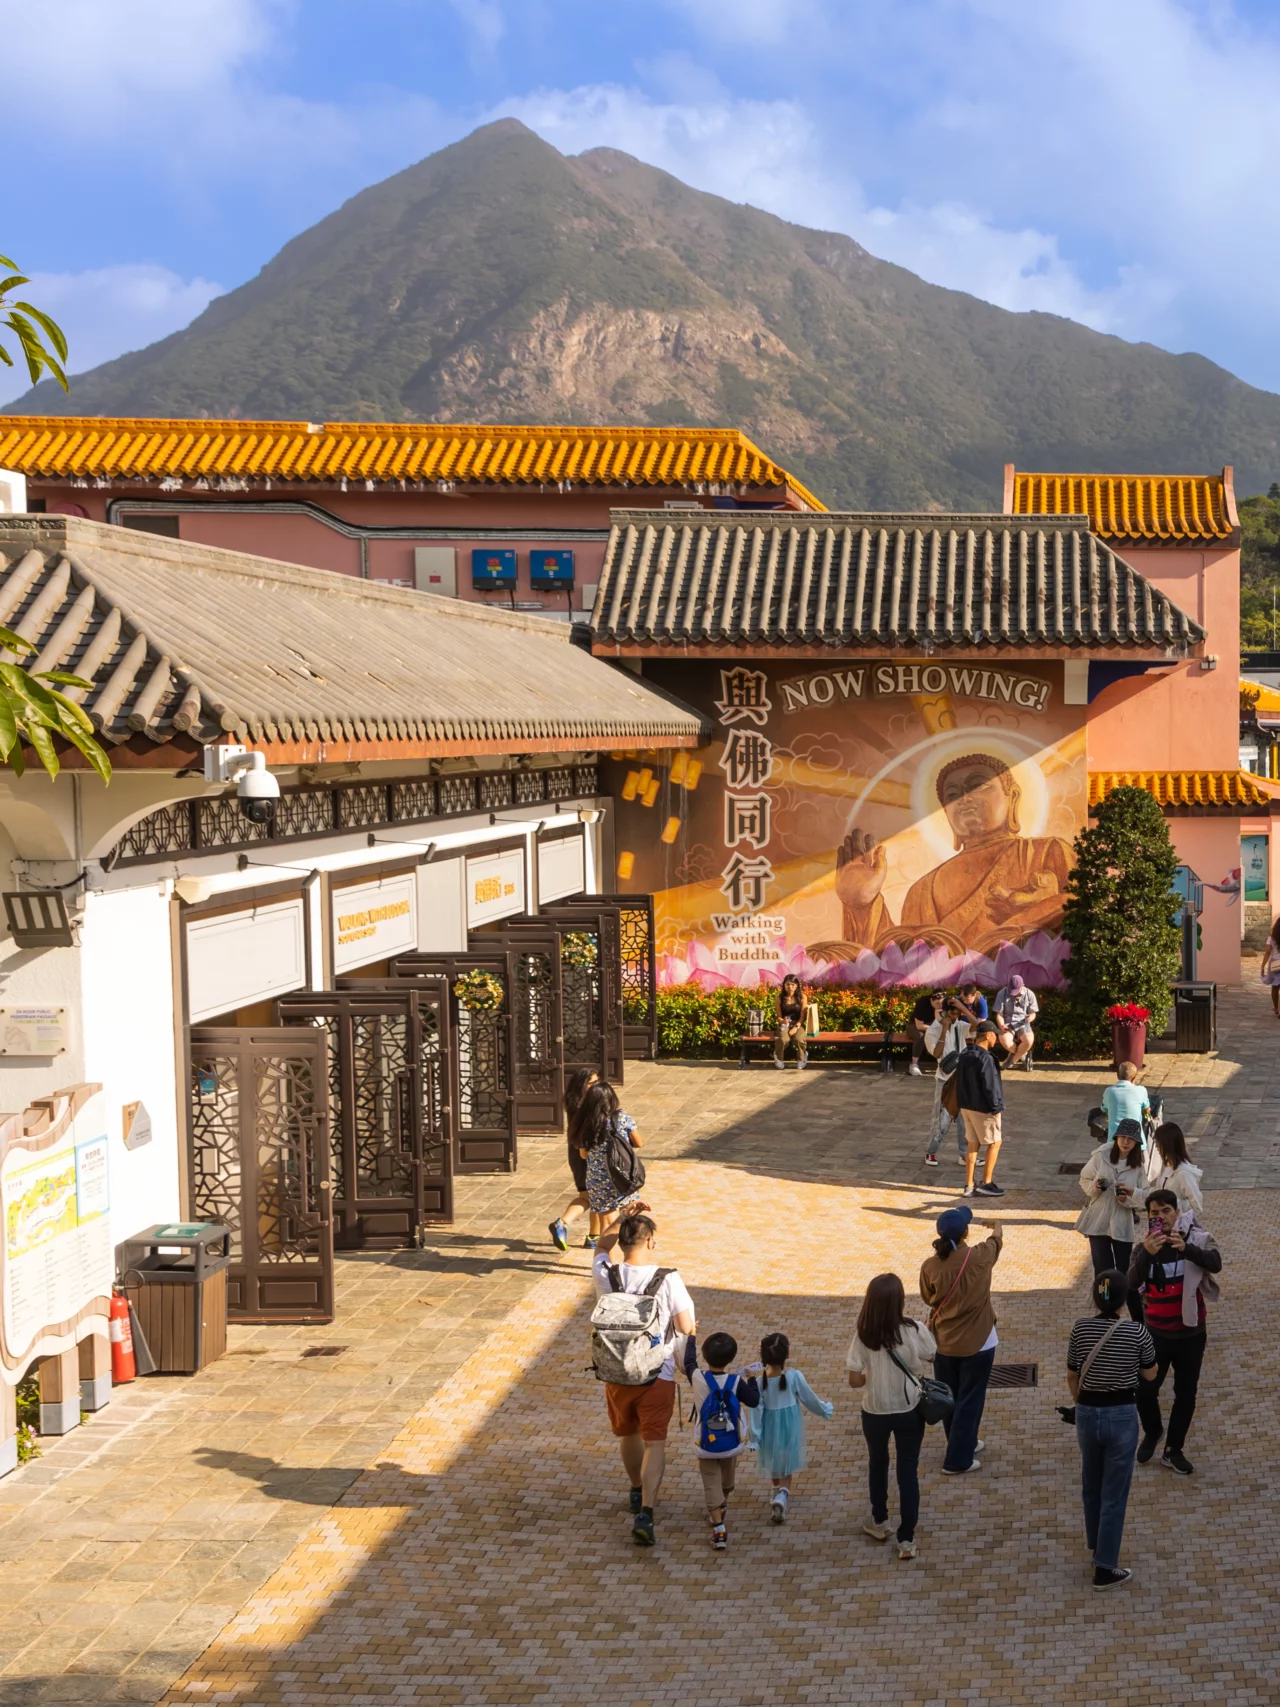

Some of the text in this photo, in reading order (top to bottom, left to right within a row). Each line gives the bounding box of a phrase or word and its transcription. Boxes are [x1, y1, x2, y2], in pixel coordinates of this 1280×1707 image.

[781, 666, 1048, 711] NOW SHOWING!
[715, 667, 774, 911] 與佛同行
[714, 916, 784, 932] Walking
[731, 932, 767, 945] with
[718, 948, 780, 961] Buddha
